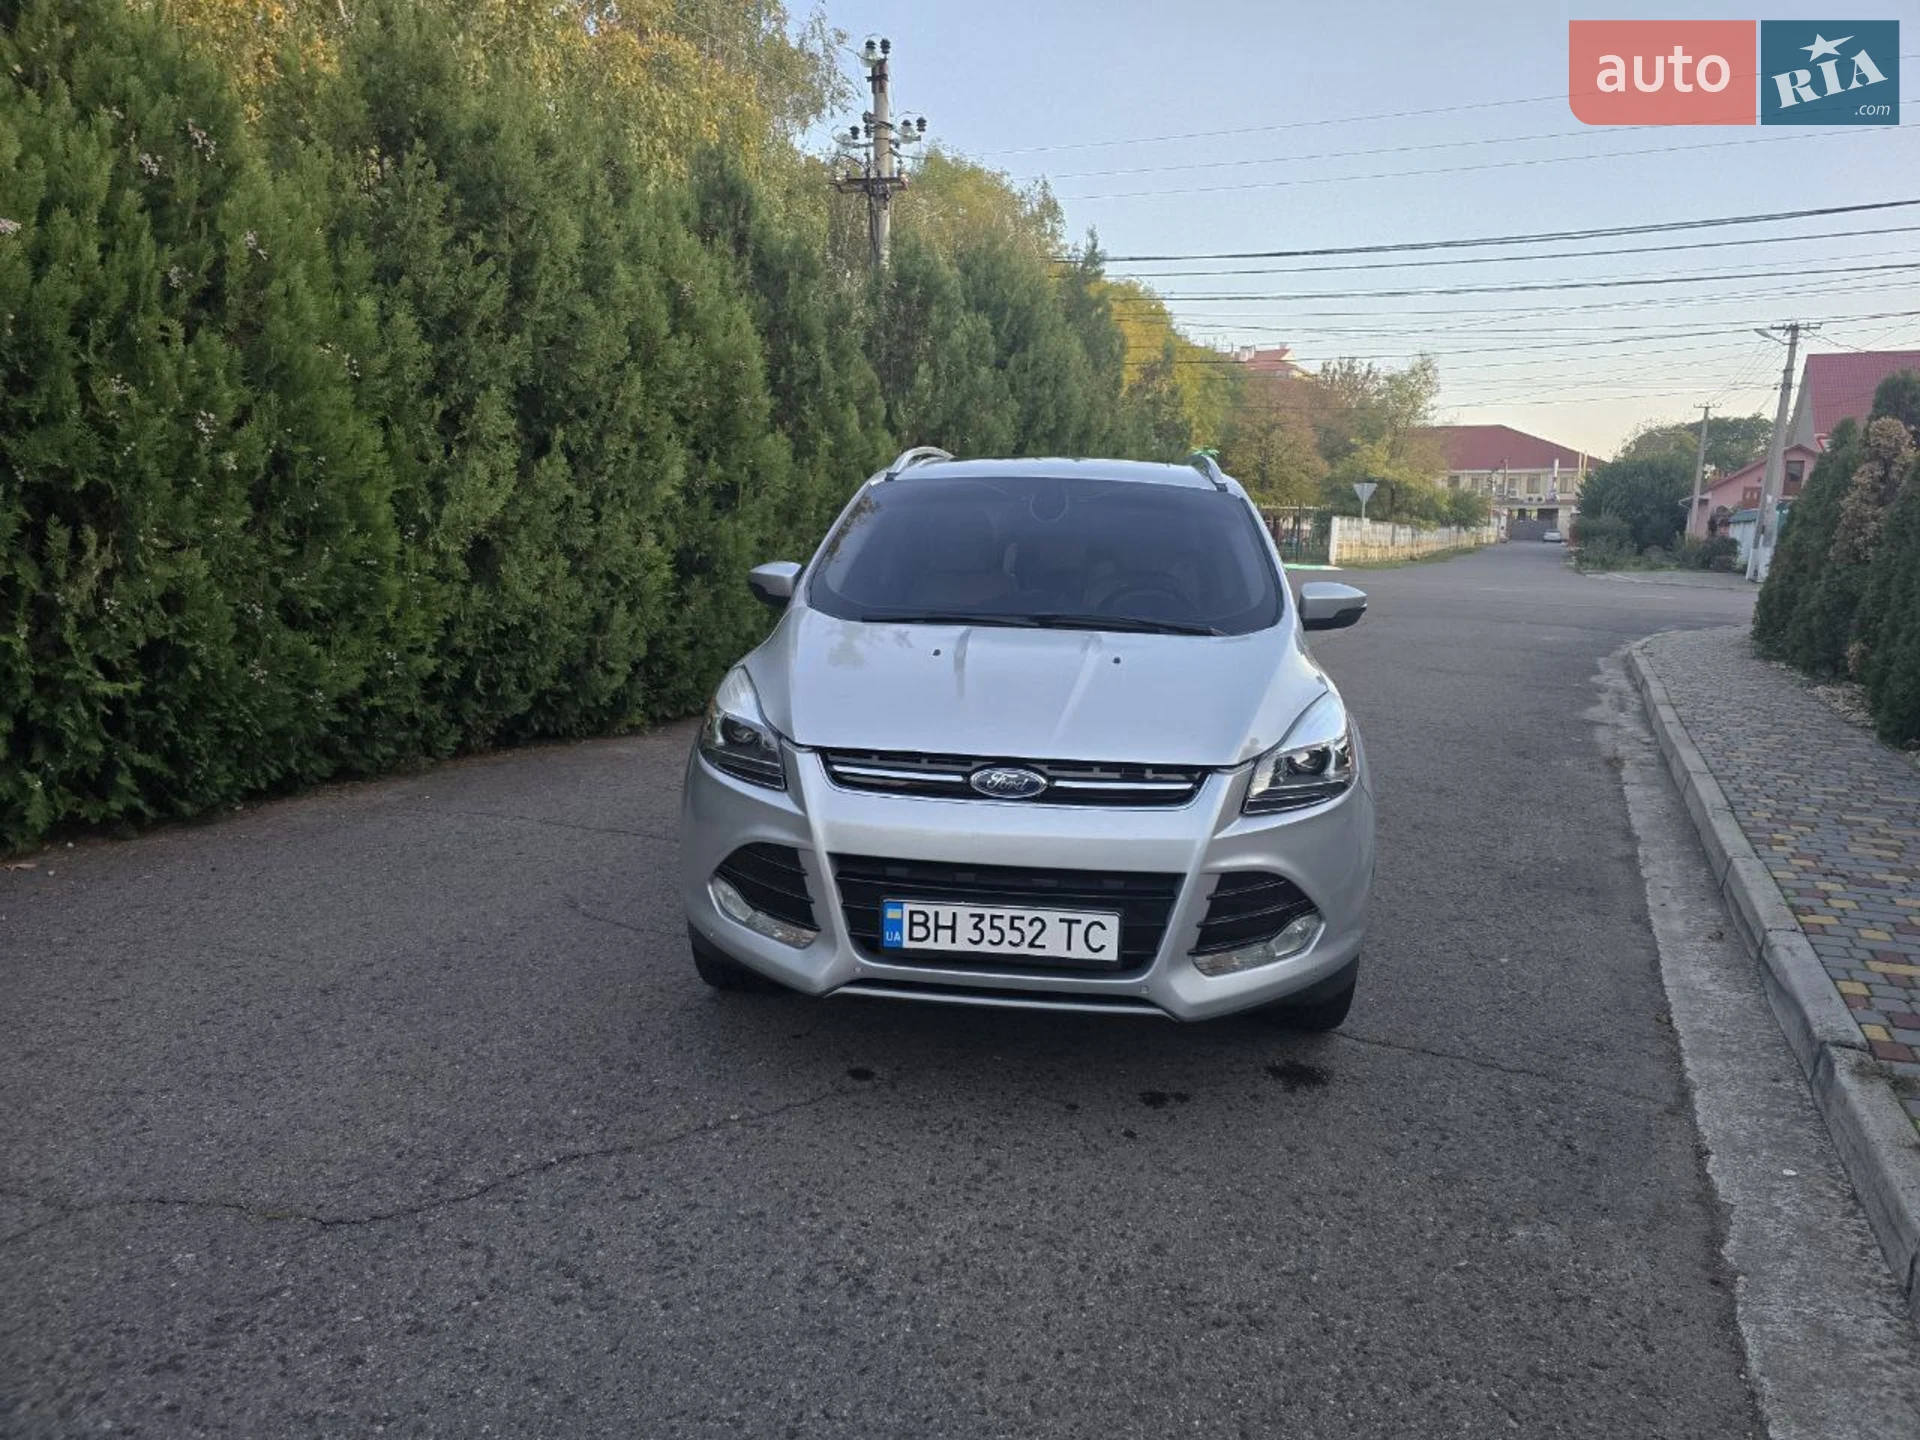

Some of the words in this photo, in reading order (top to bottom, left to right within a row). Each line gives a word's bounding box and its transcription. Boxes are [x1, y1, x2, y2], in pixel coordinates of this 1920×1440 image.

[986, 771, 1029, 791] Ford
[885, 931, 901, 942] UA
[908, 910, 957, 944] BH
[967, 913, 1047, 949] 3552
[1058, 917, 1107, 953] TC
